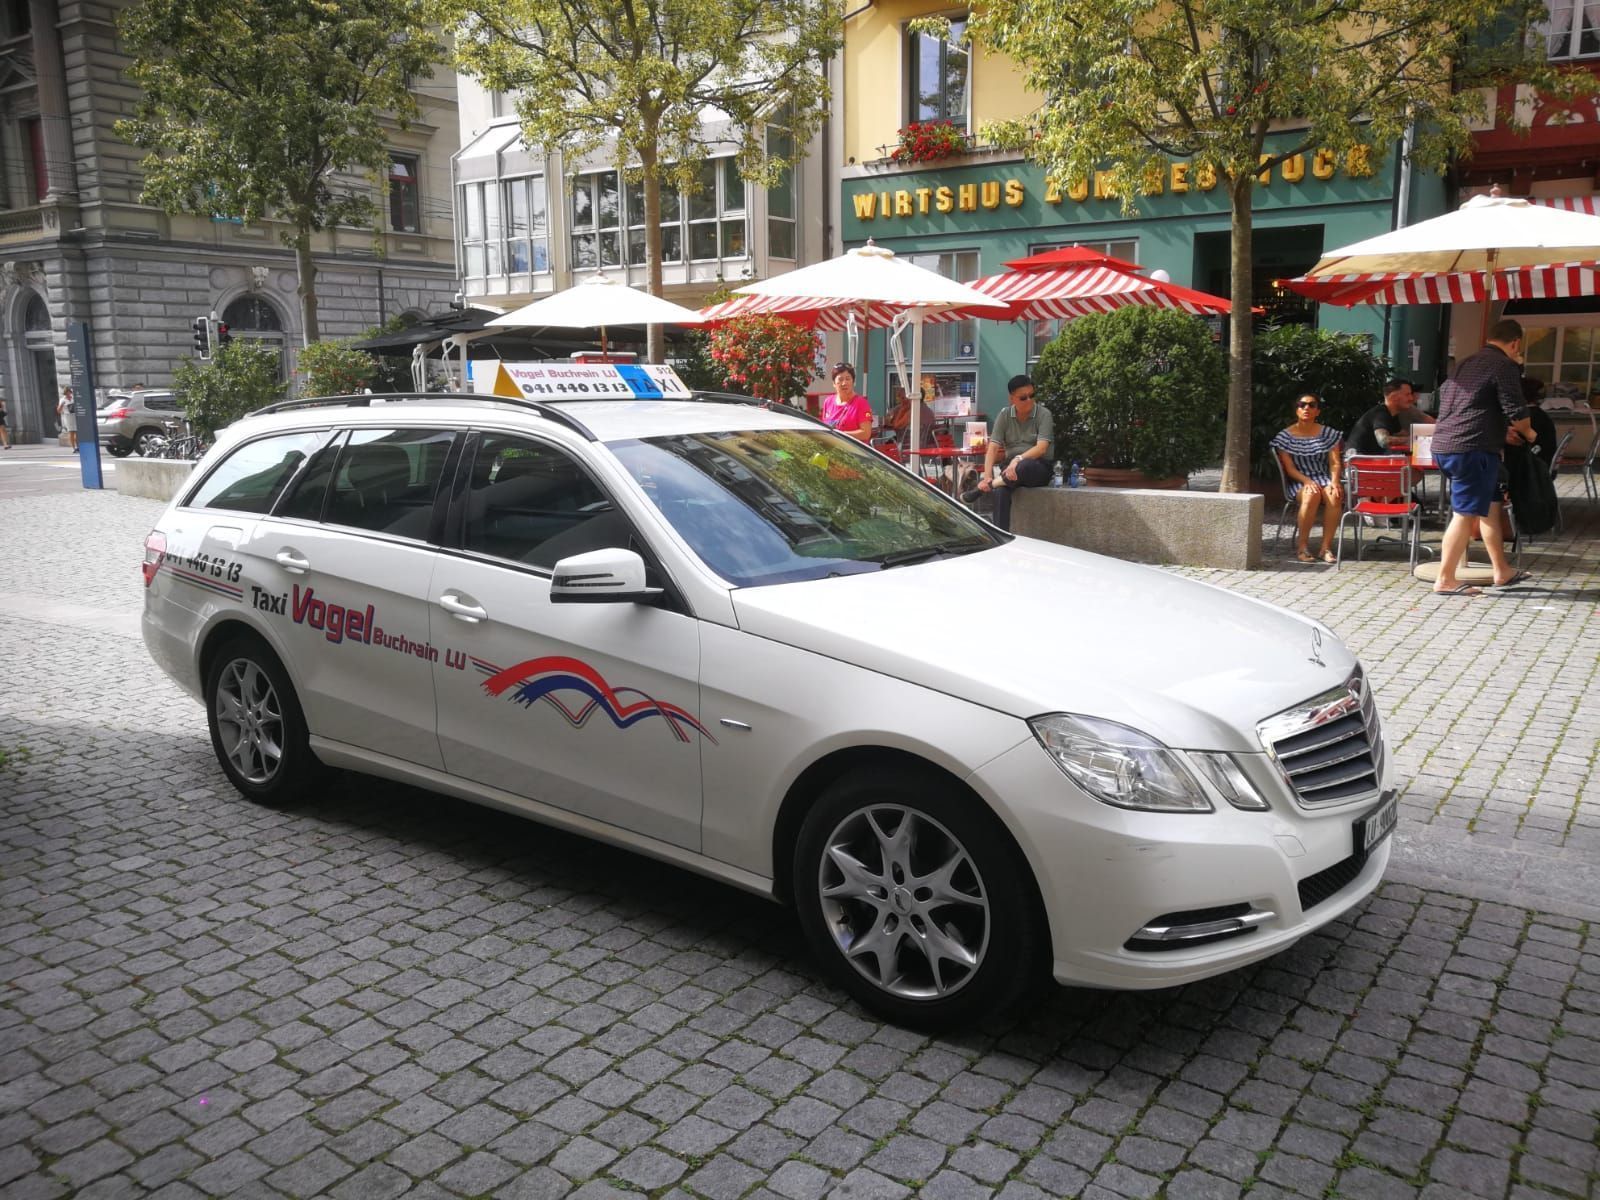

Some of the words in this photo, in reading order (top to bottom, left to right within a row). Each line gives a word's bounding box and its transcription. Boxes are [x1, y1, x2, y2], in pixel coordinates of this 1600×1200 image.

[852, 178, 1025, 220] WIRTSHUS
[510, 369, 545, 379] Vogel
[547, 369, 600, 378] Buchrain
[602, 370, 618, 378] LU
[522, 383, 553, 393] 041
[556, 383, 589, 393] 440
[593, 383, 609, 392] 13
[612, 383, 628, 392] 13
[625, 378, 682, 392] TAXI
[211, 557, 226, 577] 13
[227, 562, 243, 583] 13
[251, 585, 289, 616] Taxi
[292, 583, 375, 646] Vogel
[373, 626, 439, 662] Buchrain
[445, 648, 467, 670] LU
